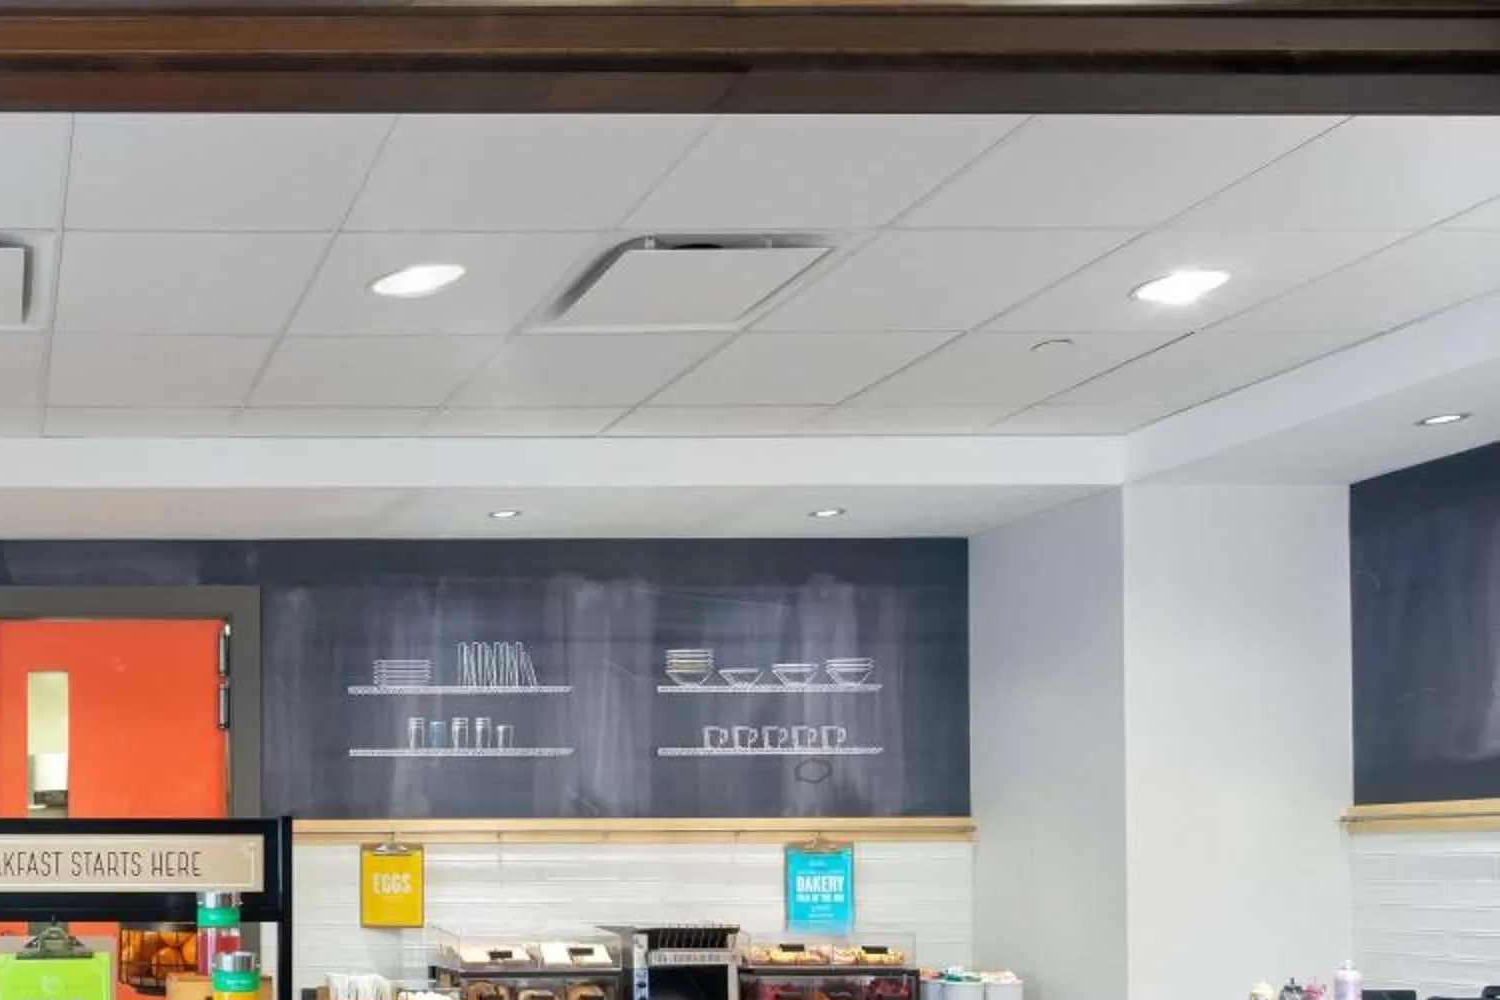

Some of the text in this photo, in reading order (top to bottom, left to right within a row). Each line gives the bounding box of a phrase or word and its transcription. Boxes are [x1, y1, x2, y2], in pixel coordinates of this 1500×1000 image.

[71, 851, 142, 877] STARTS
[150, 851, 203, 877] HERE
[372, 872, 412, 895] EGGS
[795, 875, 845, 893] BAKERY
